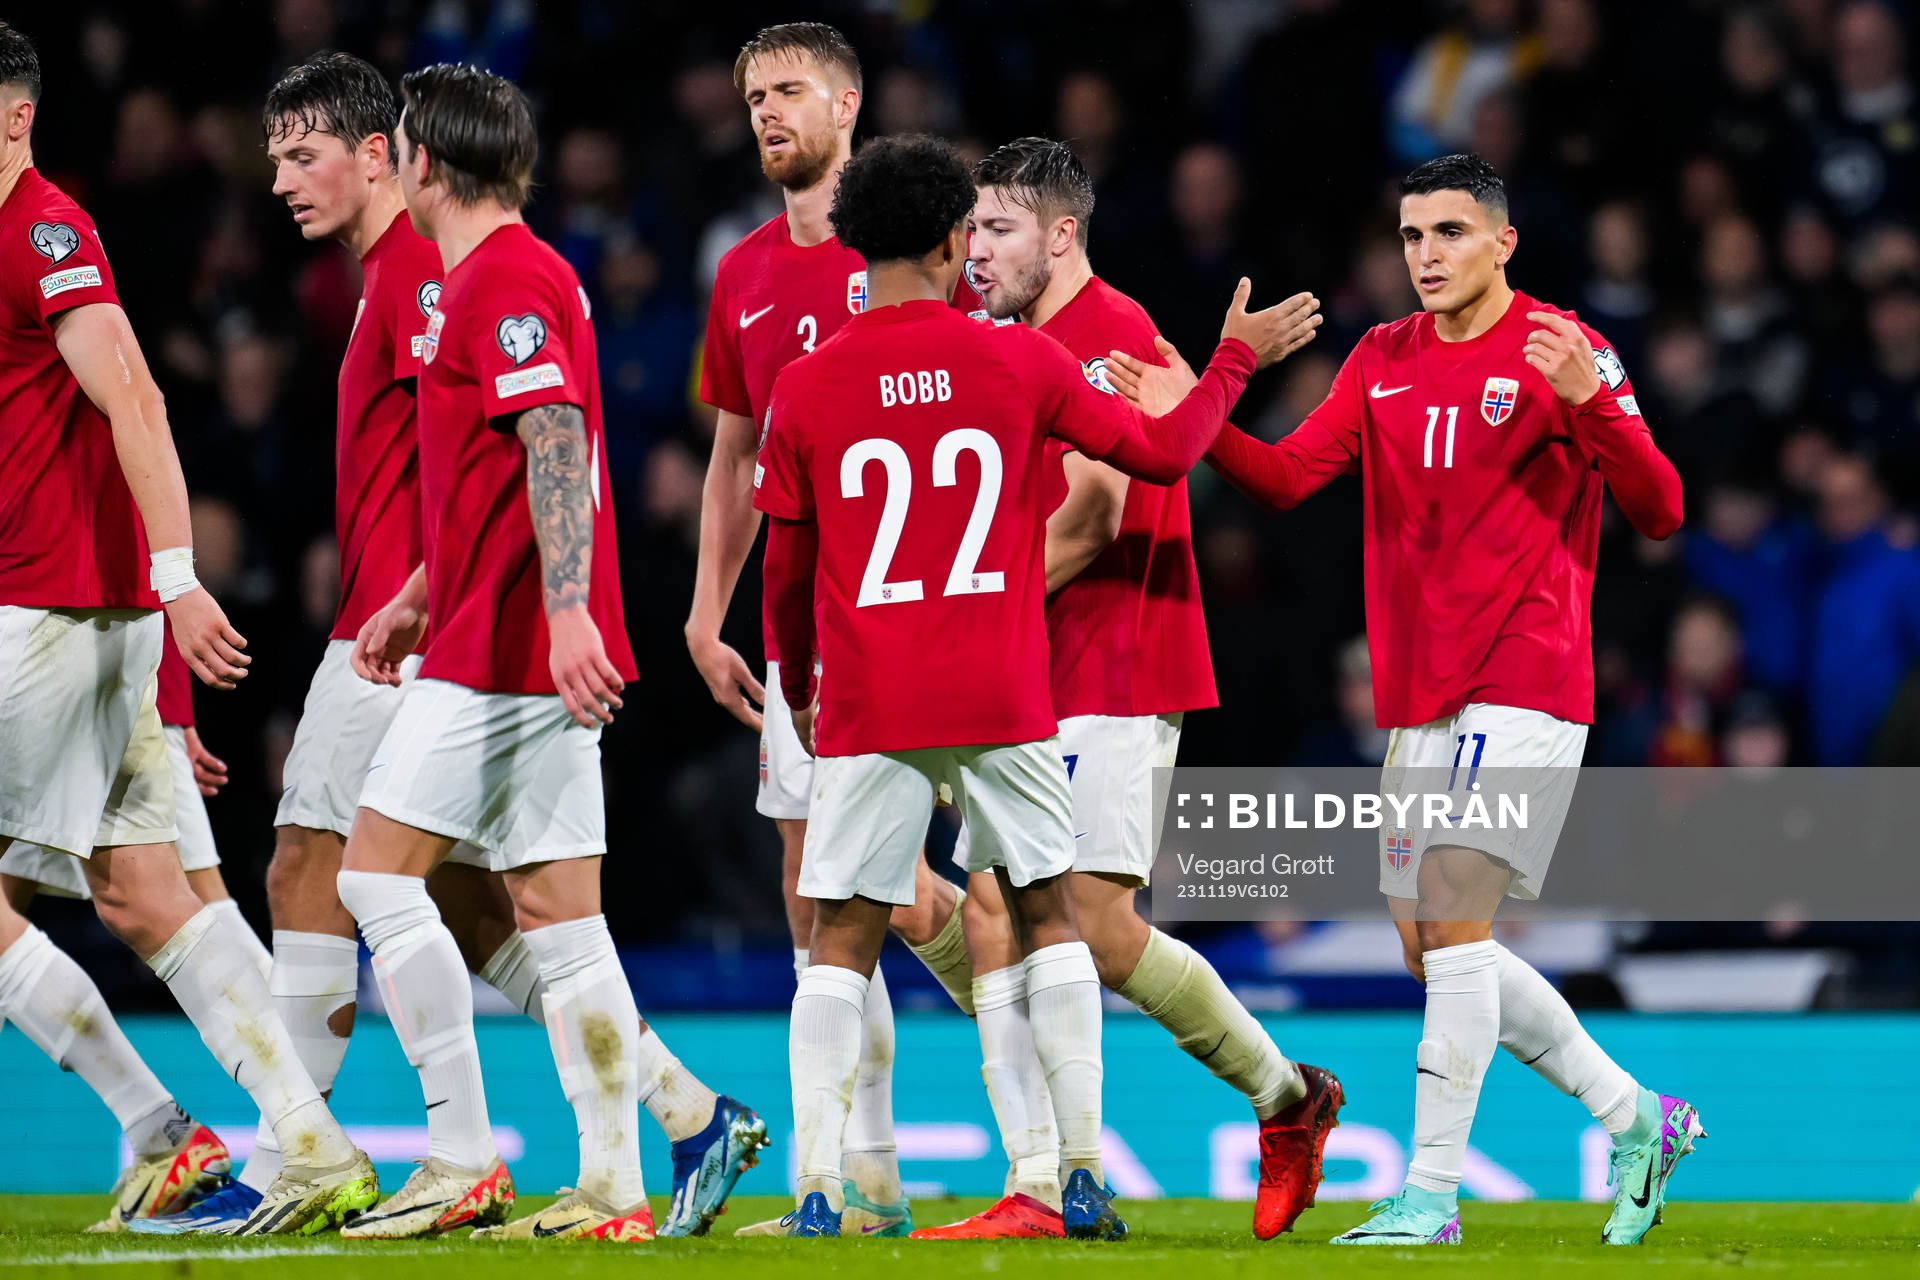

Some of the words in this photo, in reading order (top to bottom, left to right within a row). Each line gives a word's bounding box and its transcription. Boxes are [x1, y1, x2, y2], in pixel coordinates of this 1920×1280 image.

[42, 272, 99, 293] FOUNDATION
[797, 315, 818, 354] 3
[880, 369, 952, 408] BOBB
[1423, 406, 1459, 469] 11
[840, 428, 1006, 608] 22
[1447, 733, 1486, 792] 11
